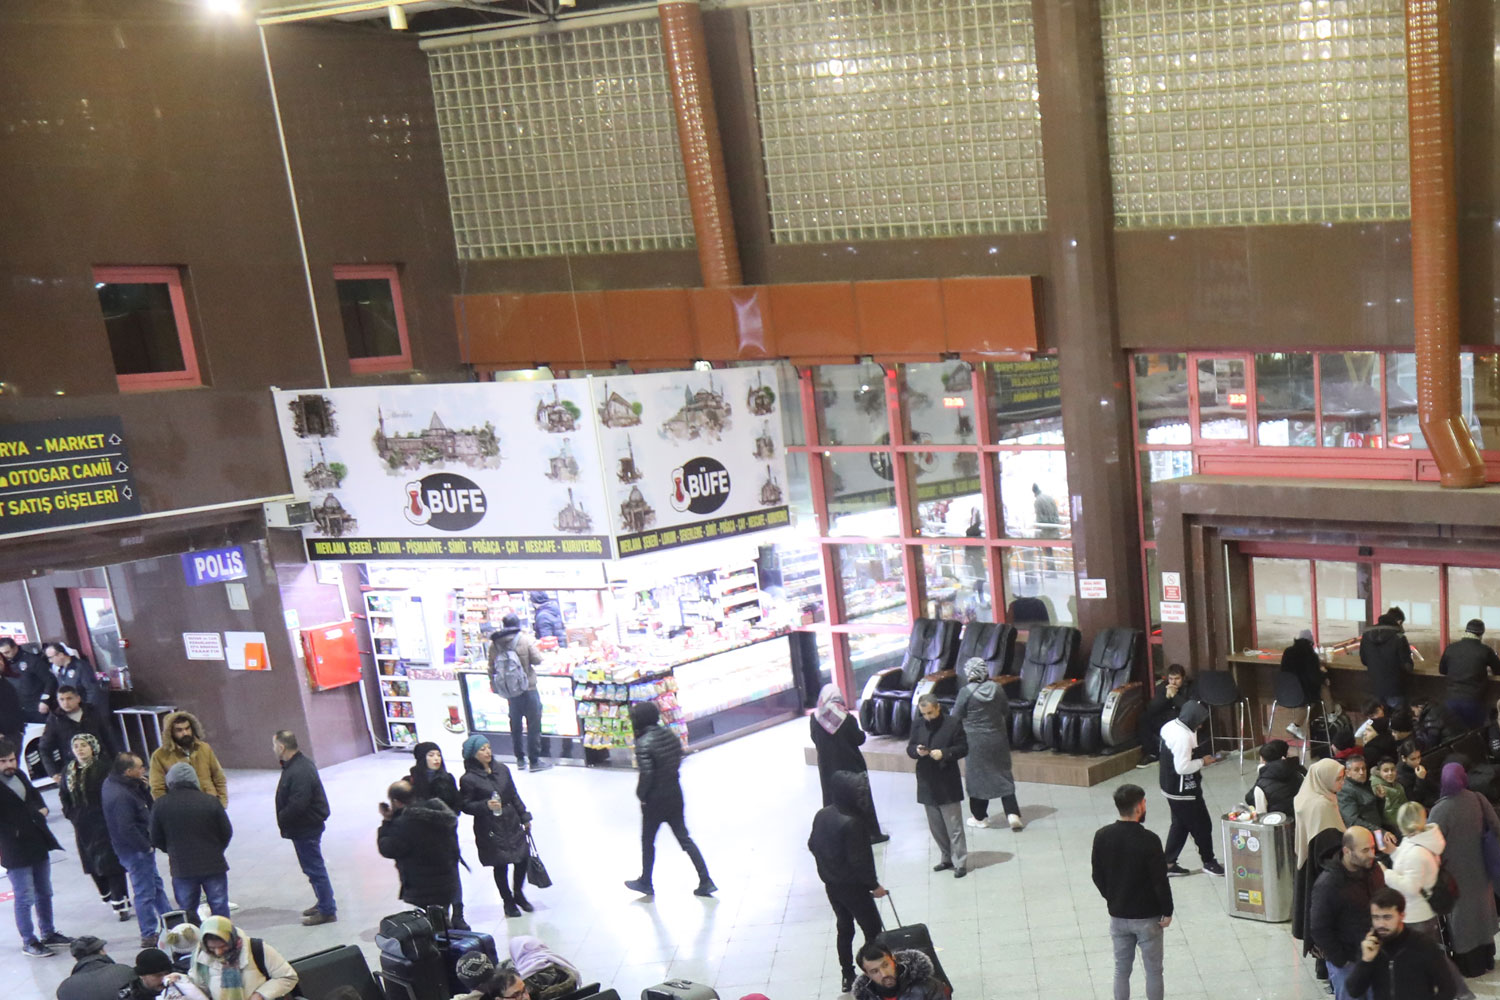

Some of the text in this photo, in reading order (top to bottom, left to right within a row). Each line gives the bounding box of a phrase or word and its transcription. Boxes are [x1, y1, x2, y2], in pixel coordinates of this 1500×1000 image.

[44, 434, 105, 453] MARKET
[9, 458, 113, 486] OTOGAR CAMİİ
[686, 467, 729, 496] BÜFE
[8, 497, 53, 515] SATIŞ
[55, 485, 120, 511] GİŞELERİ
[426, 483, 485, 514] BÜFE
[525, 539, 556, 553] NESCAFE
